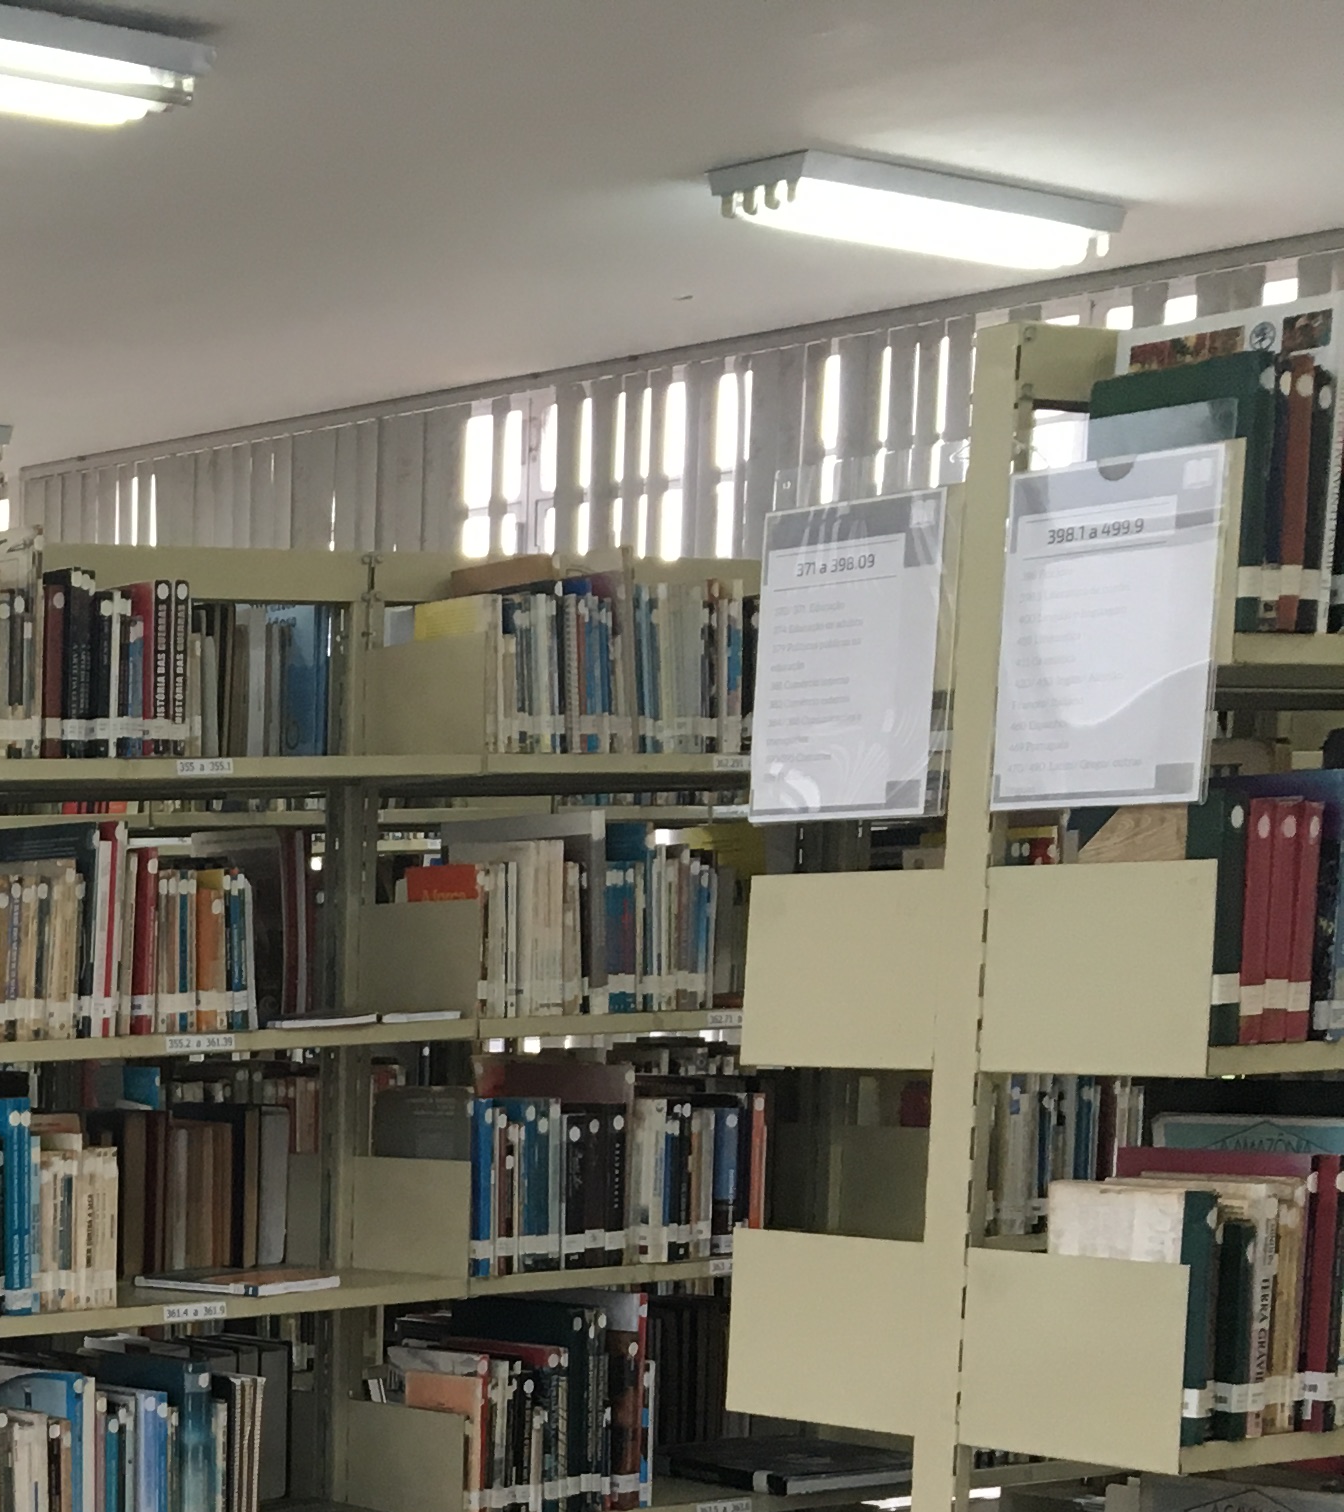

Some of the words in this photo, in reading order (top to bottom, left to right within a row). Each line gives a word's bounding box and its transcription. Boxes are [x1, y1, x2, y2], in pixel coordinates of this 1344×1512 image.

[1047, 525, 1085, 545] 398.1
[1088, 528, 1098, 540] a
[1101, 518, 1145, 537] 499.9
[796, 560, 817, 577] 371
[819, 563, 828, 574] a
[830, 553, 876, 574] 398.09
[156, 603, 167, 651] GUERRAS
[174, 603, 186, 652] GUERRAS
[156, 652, 167, 674] DAS
[174, 653, 186, 674] DAS
[179, 761, 195, 773] 355
[199, 763, 205, 772] a
[209, 760, 231, 772] 355.1
[168, 1038, 191, 1049] 355.2
[195, 1040, 202, 1048] a
[206, 1036, 233, 1048] 361.39
[166, 1307, 189, 1319] 361.4
[192, 1308, 199, 1317] a
[203, 1304, 226, 1316] 361.9
